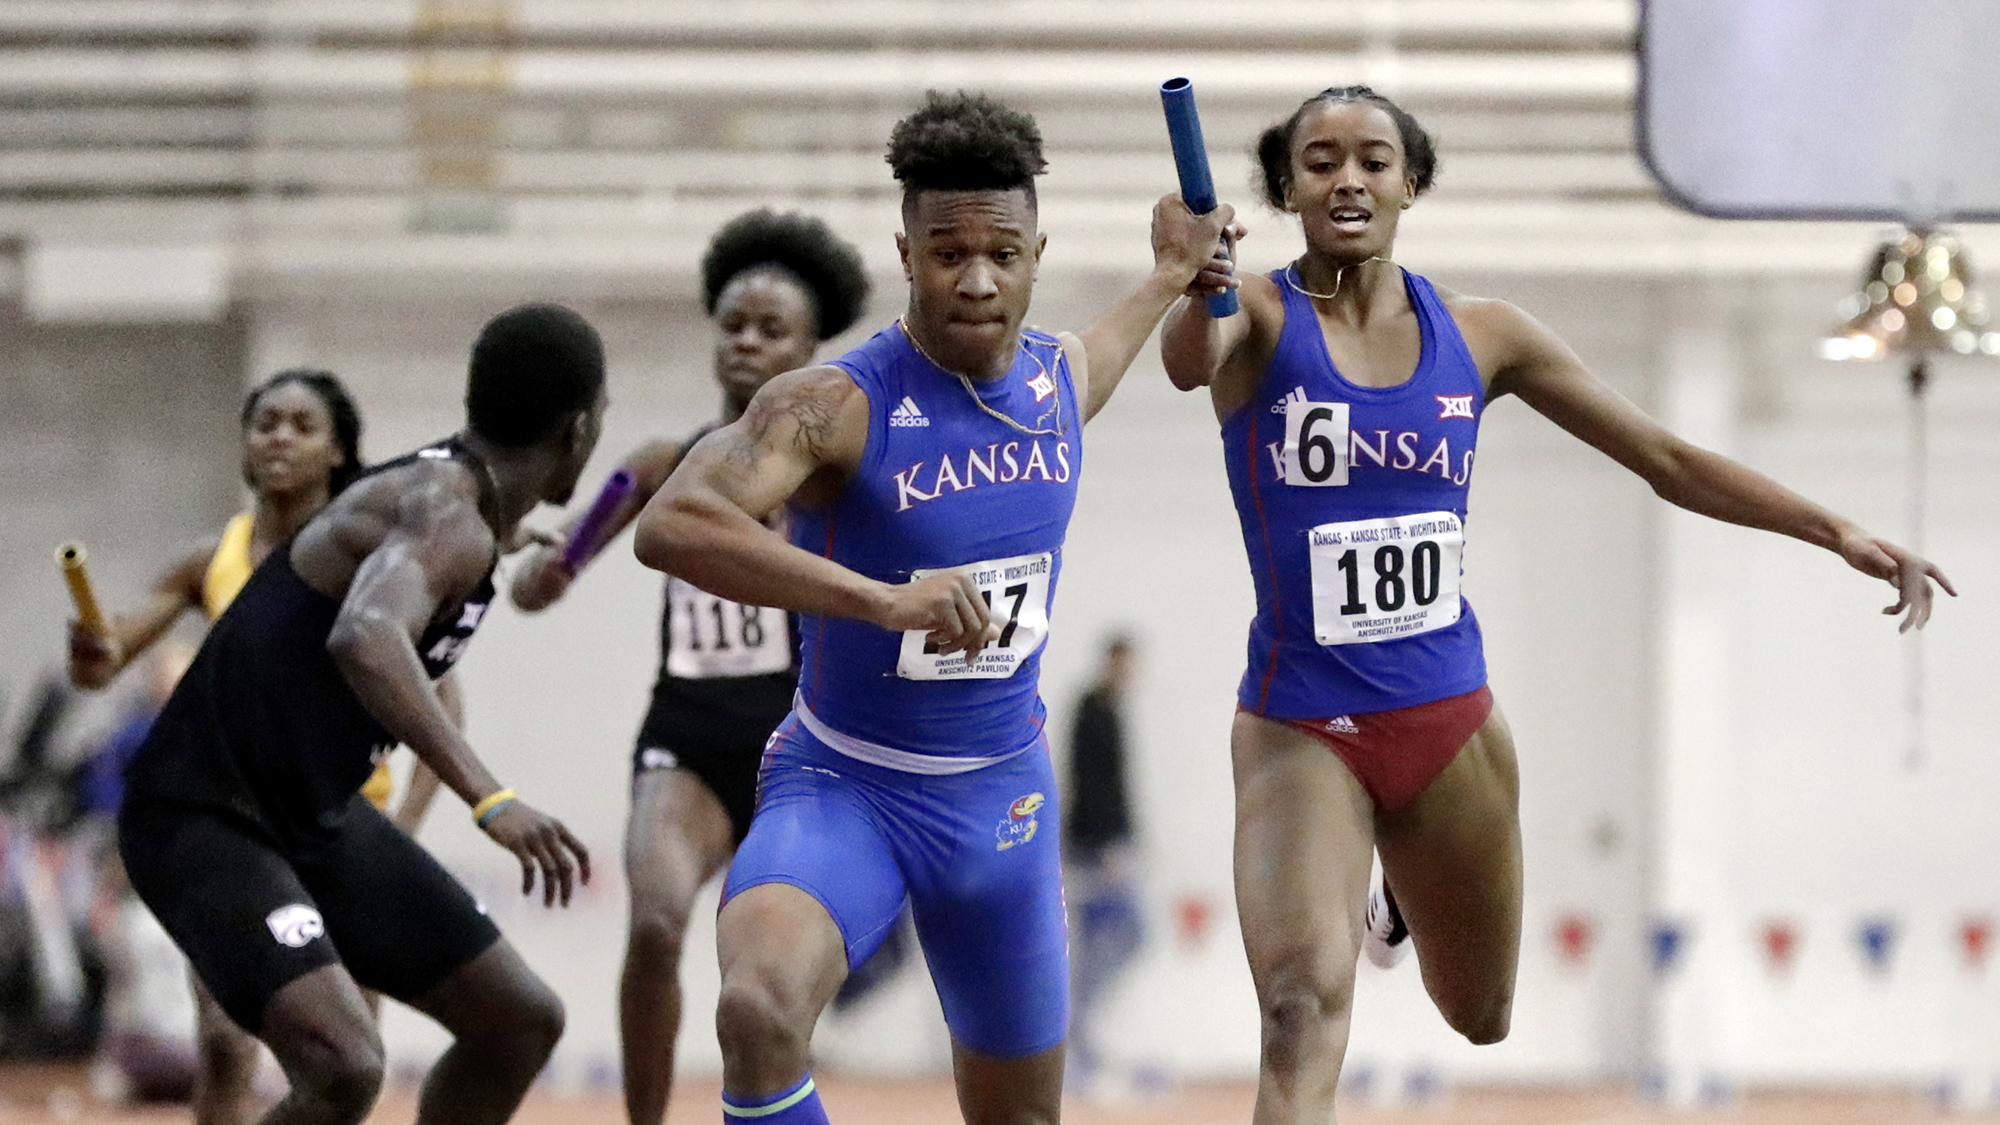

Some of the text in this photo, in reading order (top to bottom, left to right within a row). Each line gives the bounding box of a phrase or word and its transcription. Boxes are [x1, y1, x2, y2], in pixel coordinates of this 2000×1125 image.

[889, 416, 930, 427] adidas
[1298, 407, 1336, 483] 6
[1266, 430, 1474, 486] KNSAS
[893, 440, 1070, 512] KANSAS
[1313, 520, 1458, 546] KANSAS KANSAS STATE WICHITA STATE
[979, 570, 997, 585] STATE
[1004, 565, 1028, 580] WICHITA
[1028, 560, 1048, 576] STATE
[1338, 540, 1441, 616] 180
[688, 600, 763, 649] 118
[1352, 610, 1428, 628] UNIVERSITY OF KANSAS
[1358, 621, 1424, 637] ANSCHUTZ PAVILION
[985, 654, 1016, 663] KANSAS
[938, 664, 1010, 675] ANSCHUTZ PAVILION
[1325, 724, 1359, 733] adidas
[1010, 822, 1023, 834] KU
